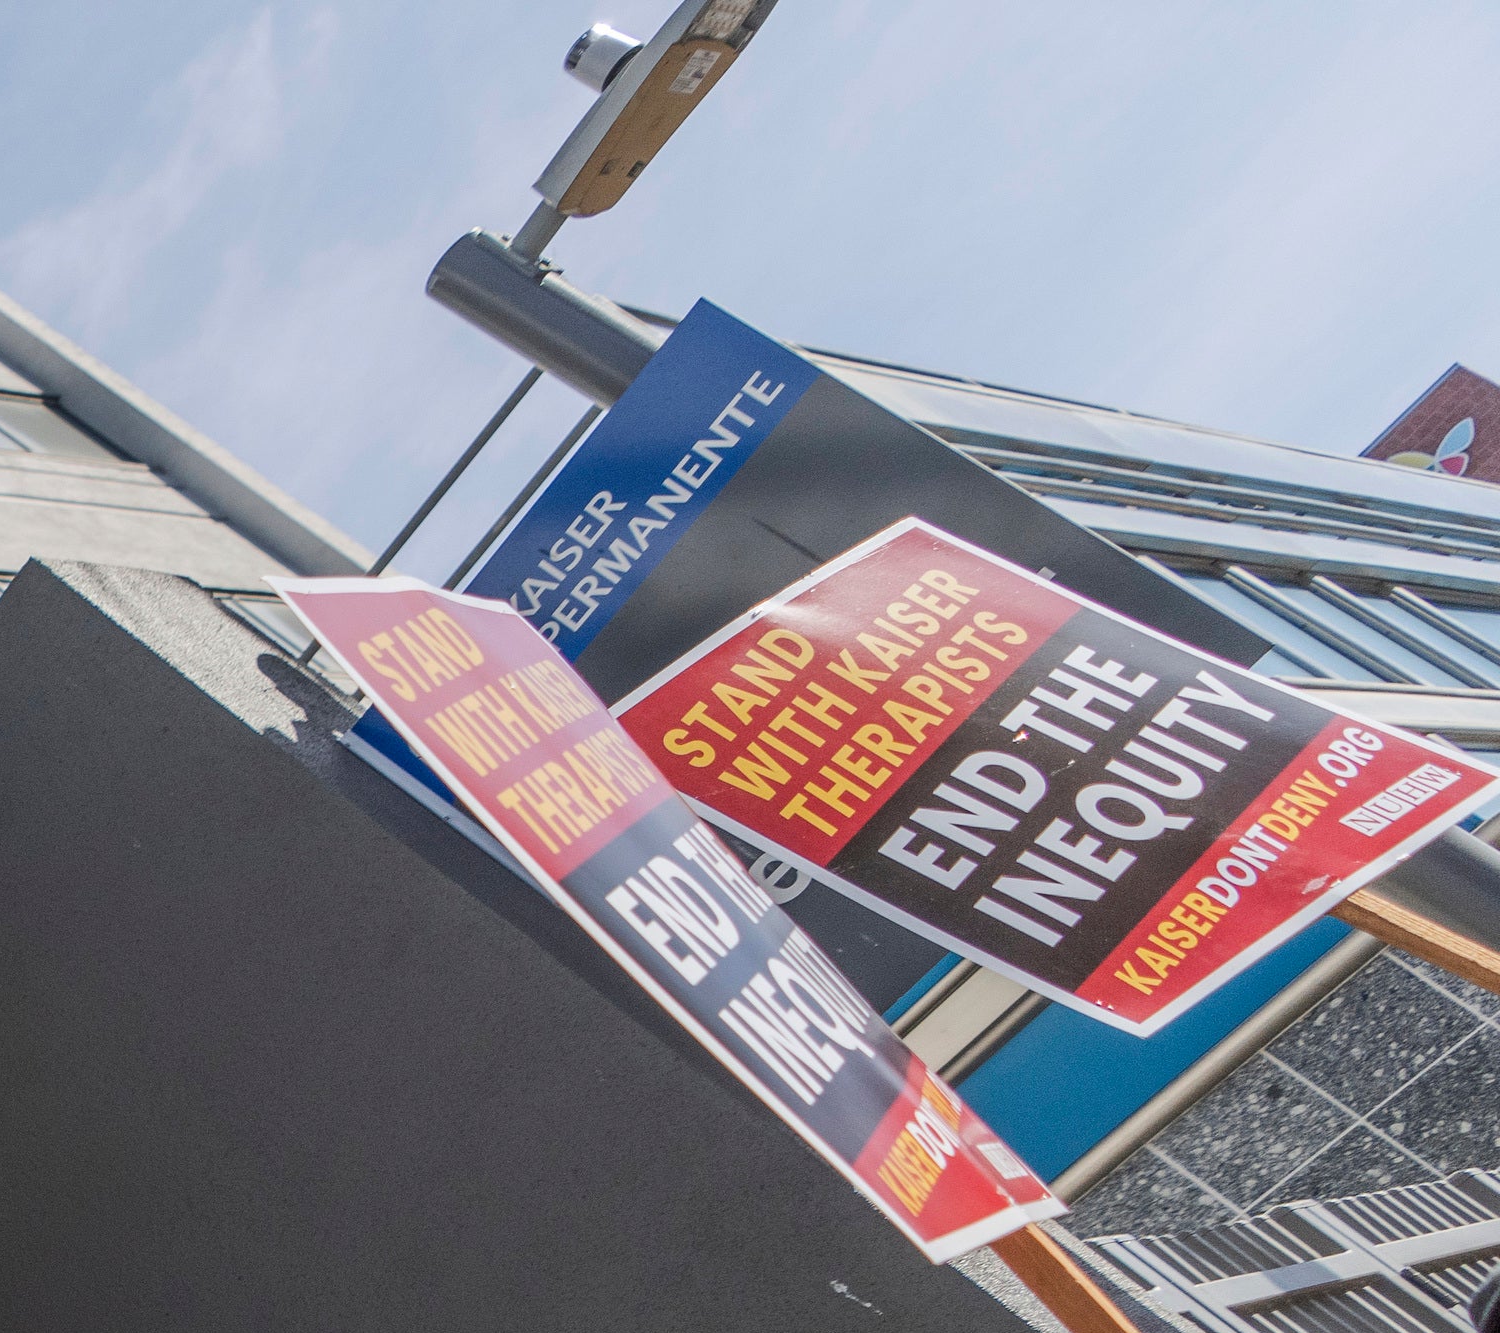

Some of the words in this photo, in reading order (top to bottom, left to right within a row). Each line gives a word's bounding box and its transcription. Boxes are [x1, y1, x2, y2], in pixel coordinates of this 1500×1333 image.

[508, 490, 628, 618] KAISER
[536, 369, 786, 646] PERMANENTE
[358, 606, 486, 702] STAND
[425, 677, 540, 778] WITH
[498, 658, 598, 736] KAISER
[662, 628, 816, 768] STAND
[717, 681, 858, 802] WITH
[827, 569, 981, 695] KAISER
[779, 610, 1029, 838] THERAPISTS
[496, 726, 658, 856] THERAPISTS
[878, 750, 1047, 891] END
[999, 643, 1160, 754] THE
[973, 670, 1276, 949] INEQUITY
[1339, 762, 1460, 838] NUHW
[605, 854, 740, 987] END
[1113, 726, 1386, 996] KAISERDONTDENY.ORG
[718, 926, 875, 1107] INEQUIT
